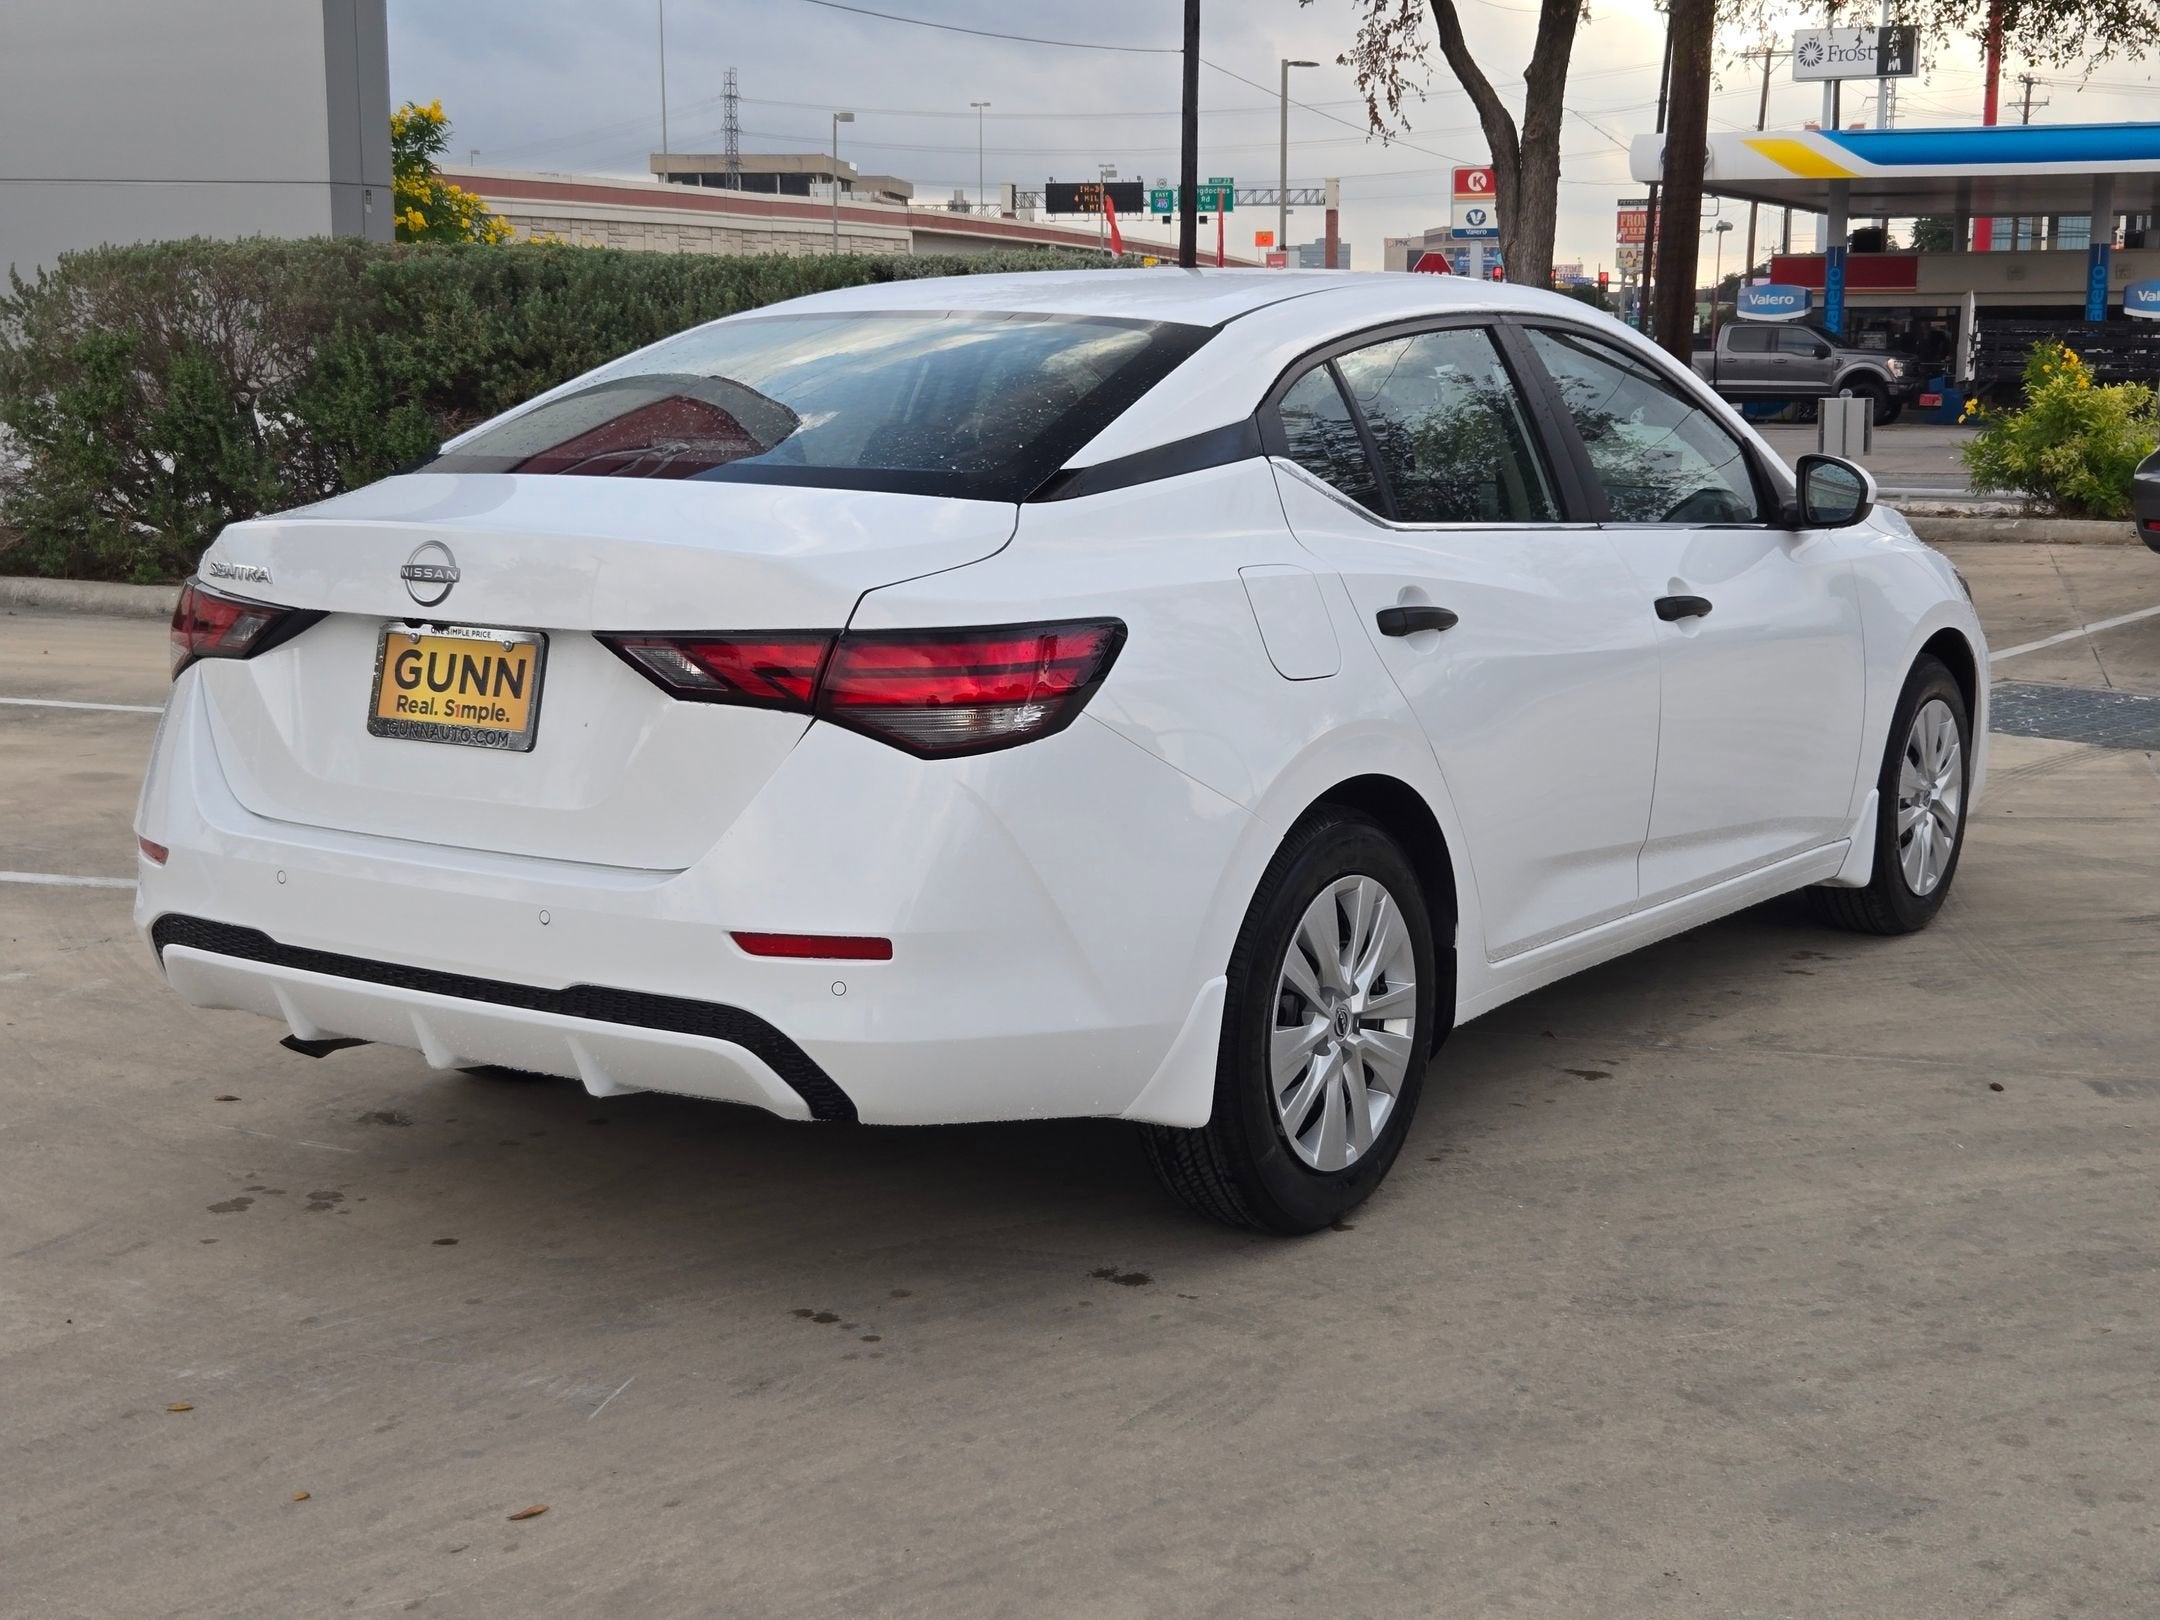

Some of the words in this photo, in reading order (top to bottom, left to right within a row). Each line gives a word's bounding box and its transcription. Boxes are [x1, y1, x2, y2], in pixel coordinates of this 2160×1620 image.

[1826, 45, 1875, 62] Frost
[1473, 176, 1485, 191] K
[1201, 195, 1210, 203] Rd
[1749, 294, 1795, 305] Valero
[2087, 265, 2106, 321] alero
[2138, 290, 2160, 302] Val
[208, 561, 274, 584] SENTRA
[401, 566, 458, 581] NISSAN
[447, 628, 470, 637] SIMPLE
[471, 630, 491, 639] PRICE
[394, 649, 527, 699] GUNN
[396, 694, 438, 716] Real.
